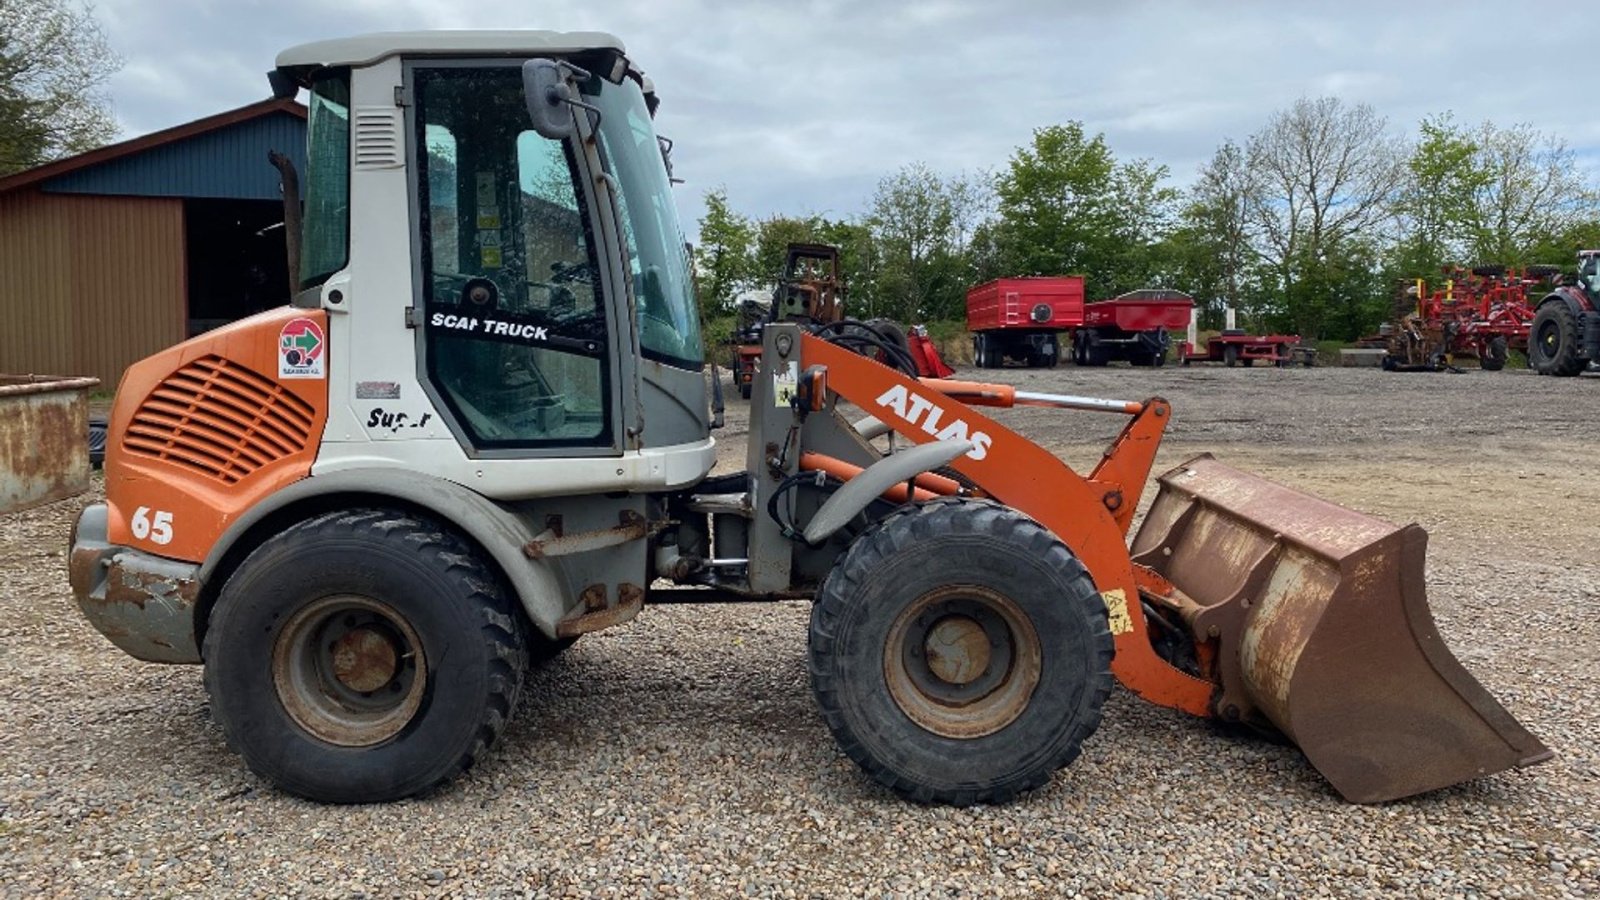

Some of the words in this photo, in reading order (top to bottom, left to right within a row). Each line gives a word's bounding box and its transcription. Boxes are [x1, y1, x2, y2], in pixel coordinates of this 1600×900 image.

[484, 320, 548, 340] TRUCK
[875, 384, 992, 461] ATLAS
[131, 506, 173, 545] 65
